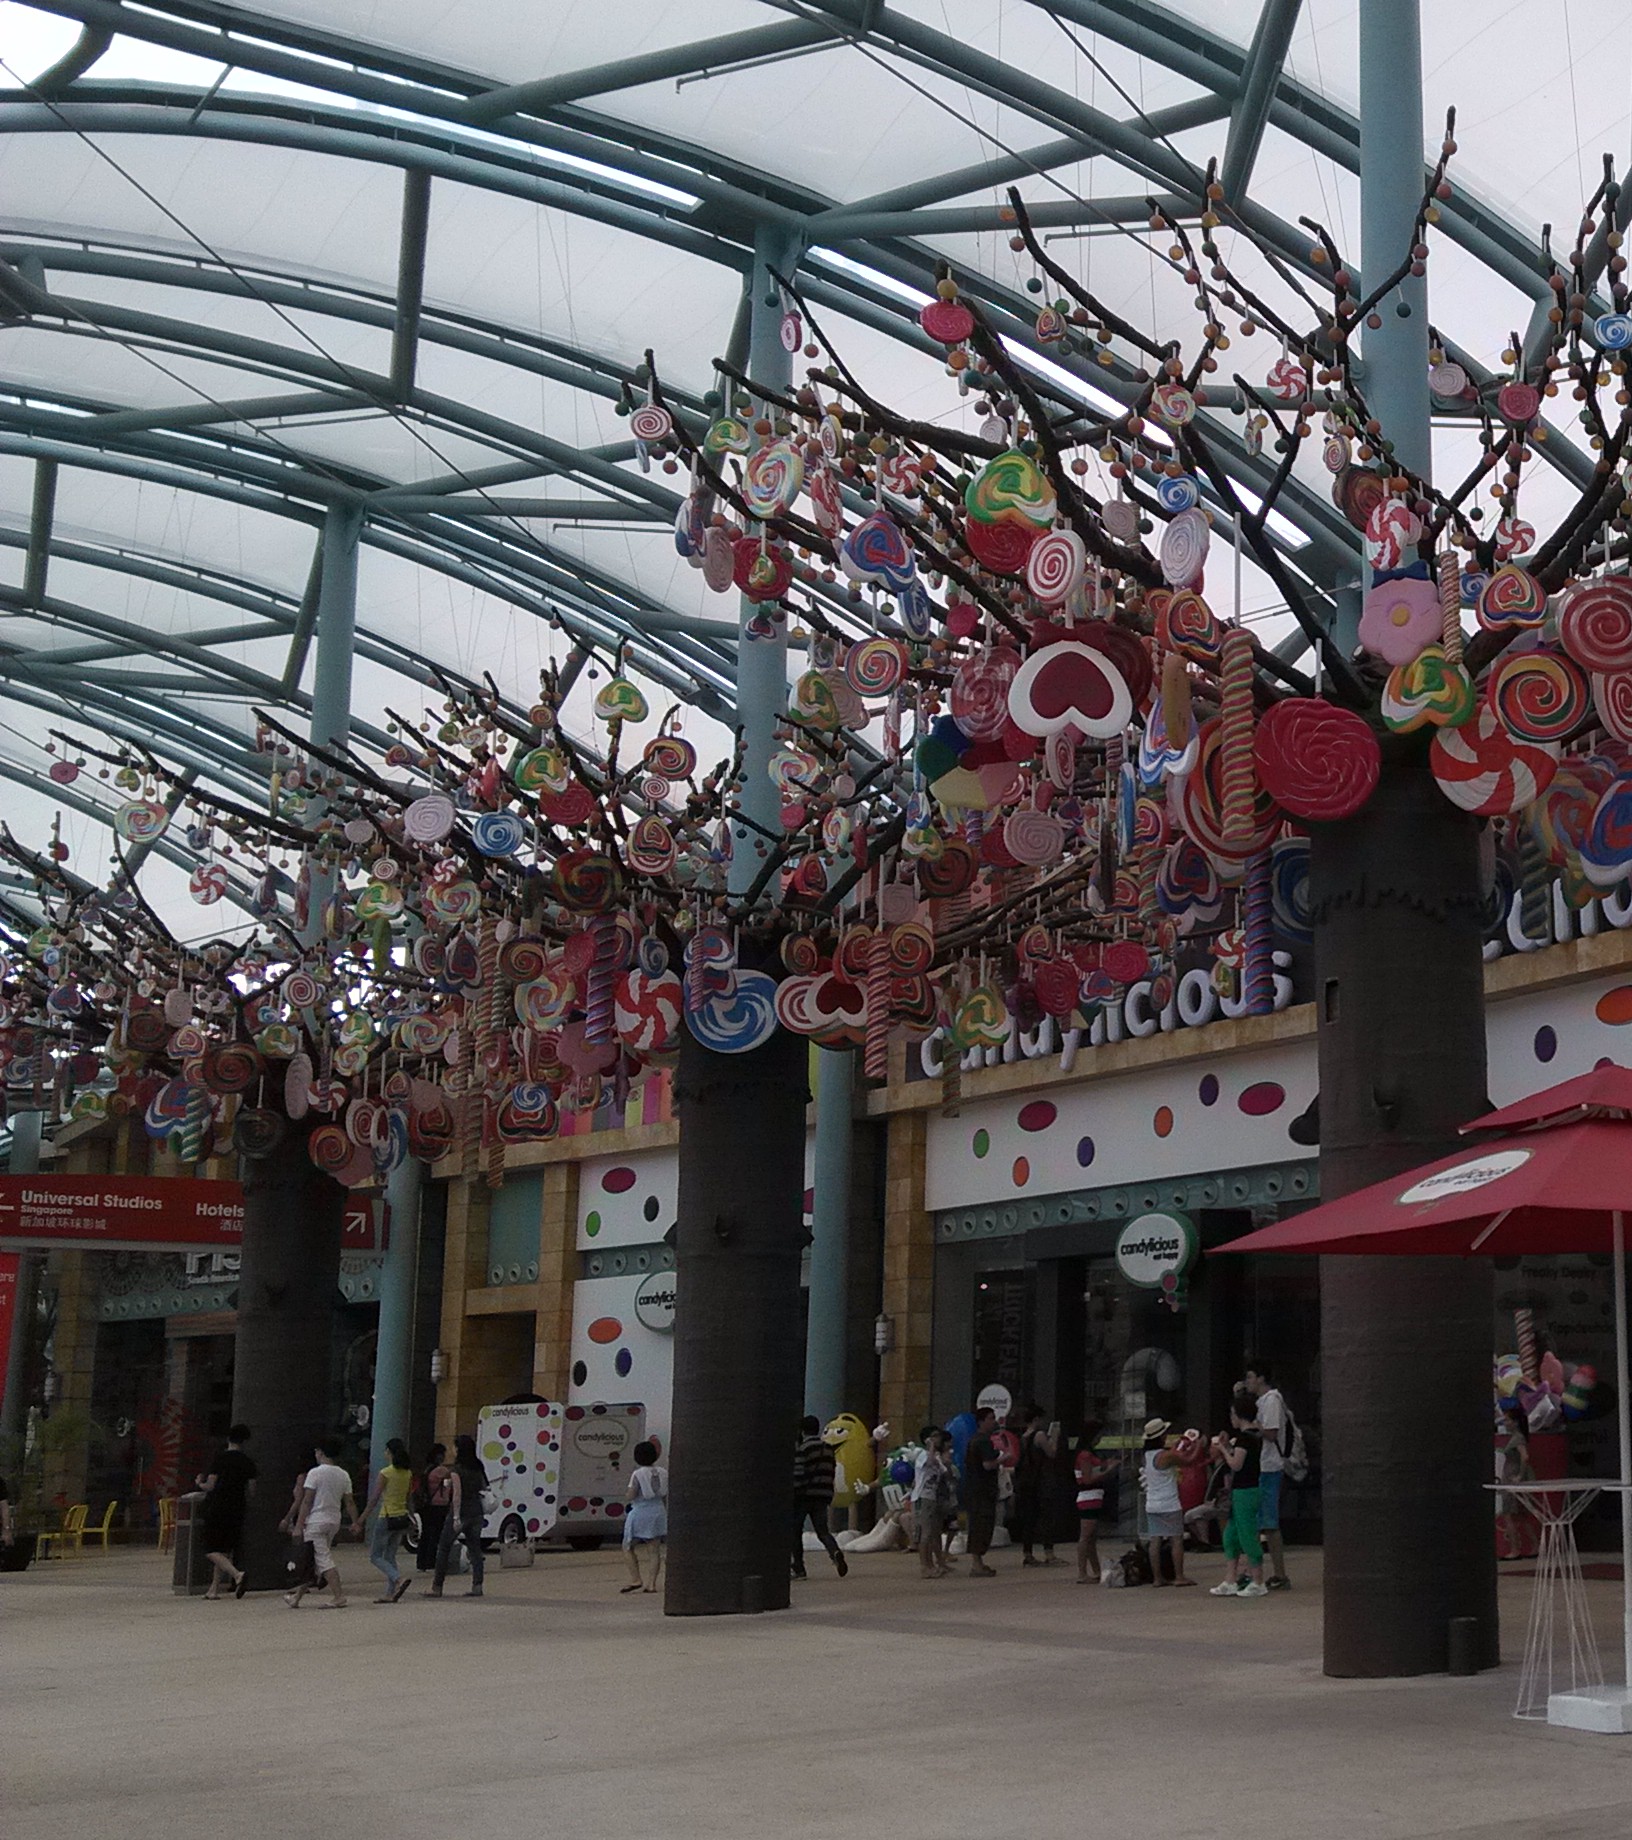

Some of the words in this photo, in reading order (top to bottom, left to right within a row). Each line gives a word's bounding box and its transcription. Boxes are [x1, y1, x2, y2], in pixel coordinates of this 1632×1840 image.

[21, 1190, 99, 1207] Universal
[103, 1194, 163, 1210] Studios
[21, 1205, 73, 1216] Singapore
[196, 1203, 244, 1217] Hotels
[1121, 1236, 1179, 1256] candylicious
[492, 1407, 529, 1418] candylicious
[578, 1431, 624, 1442] candylicious
